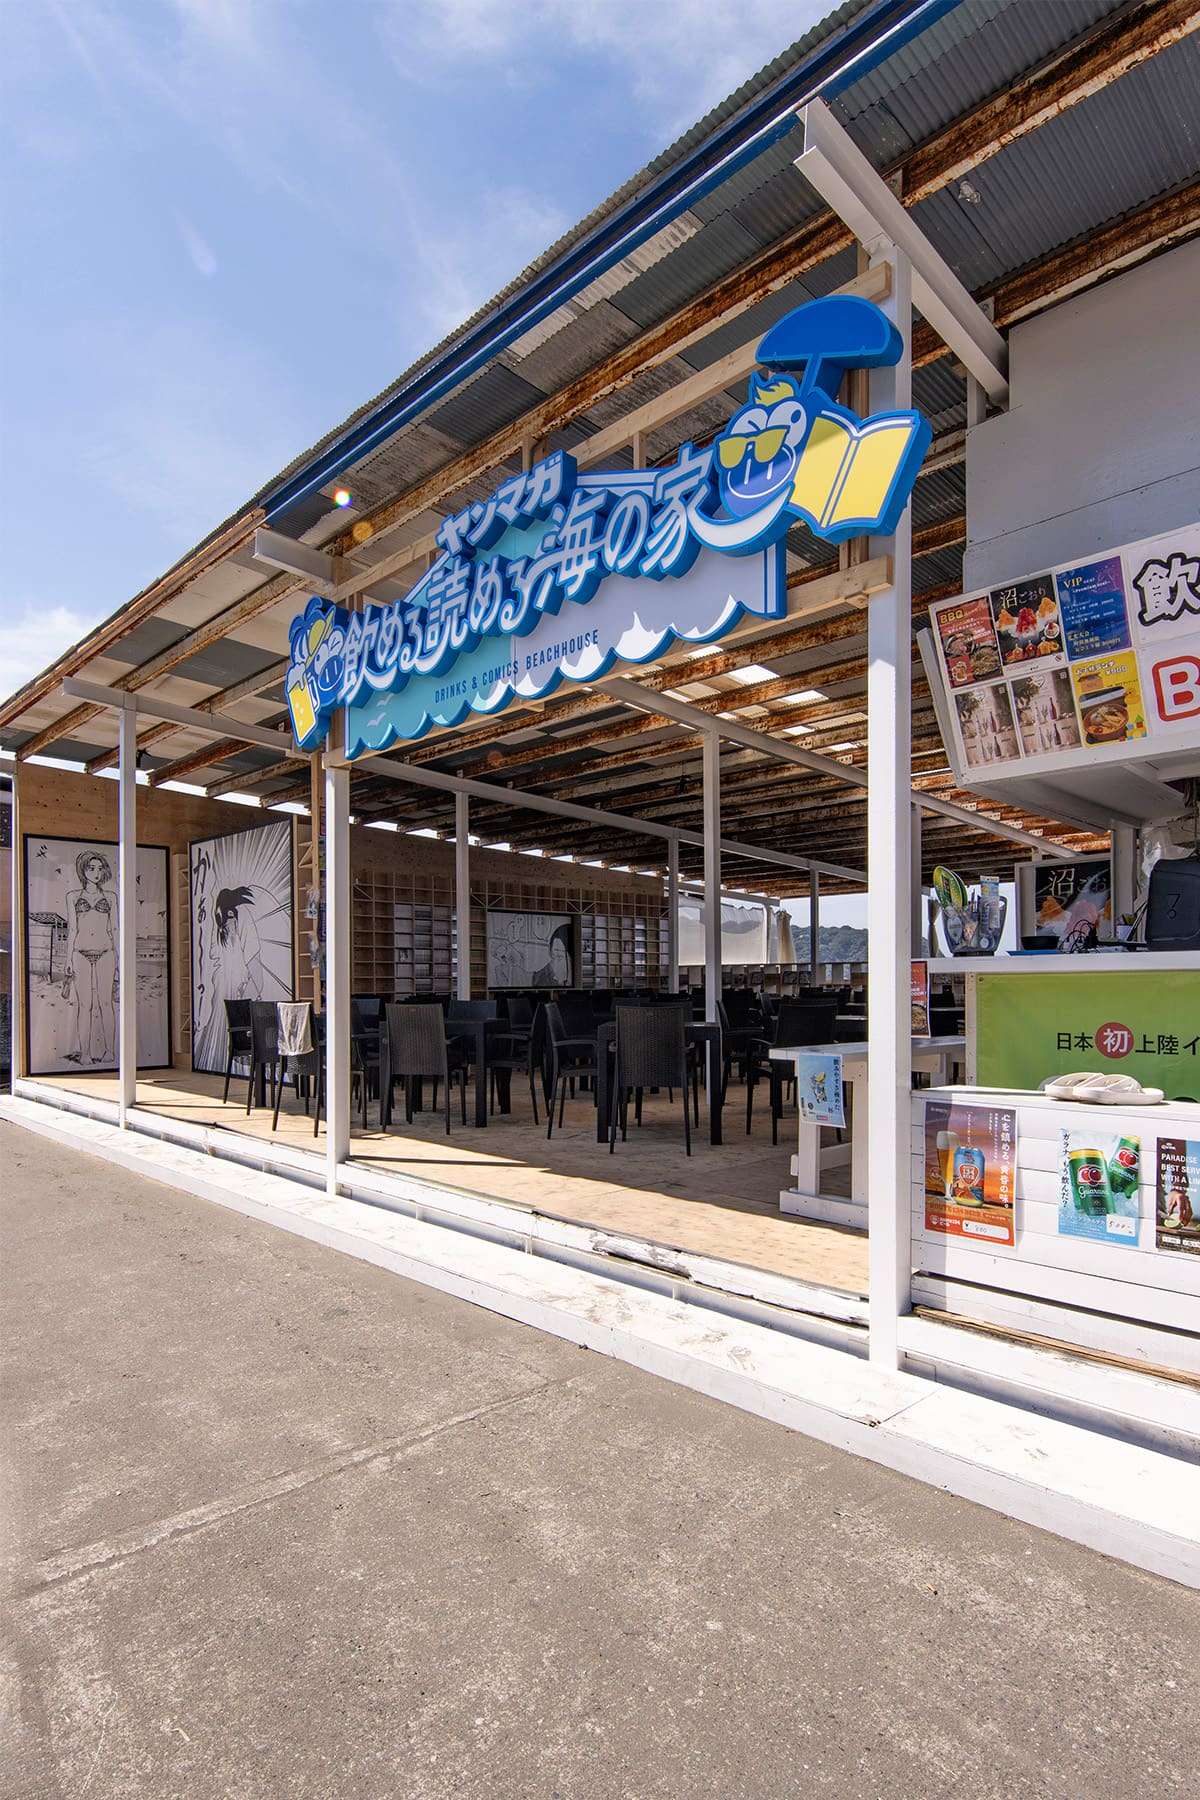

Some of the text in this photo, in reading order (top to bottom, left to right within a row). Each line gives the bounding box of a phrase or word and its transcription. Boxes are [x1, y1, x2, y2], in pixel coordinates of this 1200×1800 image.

[1063, 577, 1082, 589] VIP
[1133, 553, 1200, 627] 飲
[939, 608, 964, 624] BBQ
[435, 629, 599, 703] DRINKS & COMICS BEACHHOUSE
